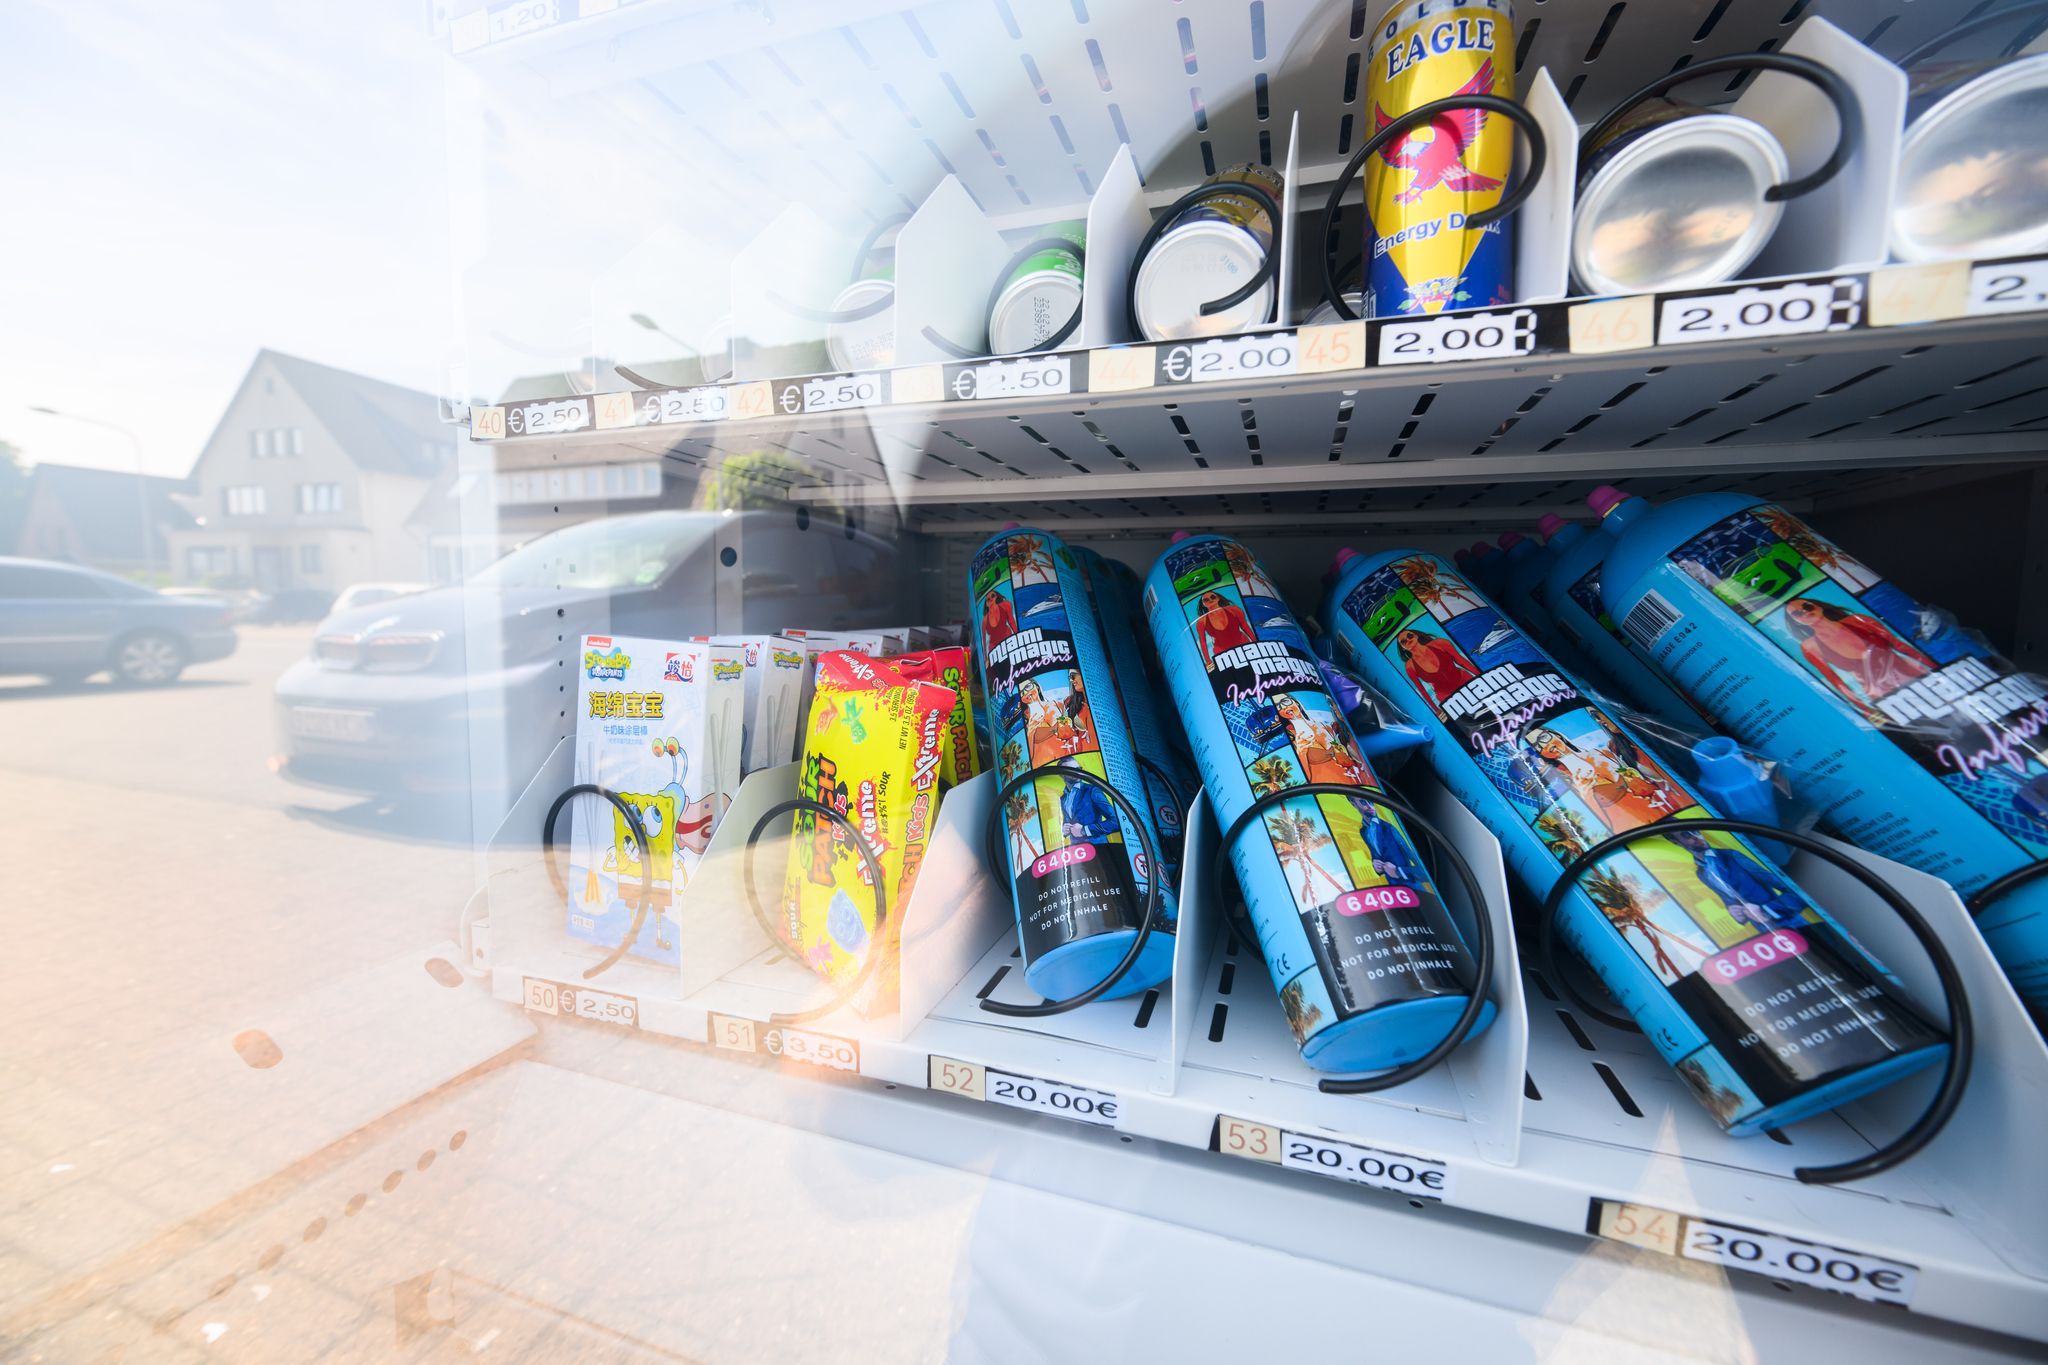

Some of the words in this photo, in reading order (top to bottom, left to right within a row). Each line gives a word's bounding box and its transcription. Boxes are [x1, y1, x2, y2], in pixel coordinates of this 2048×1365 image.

[1386, 18, 1495, 82] EAGLE
[1374, 219, 1441, 258] Energy
[1893, 273, 1954, 313] 47
[1581, 306, 1639, 341] 46
[1680, 296, 1815, 333] 2,00
[1304, 331, 1352, 365] 45
[1394, 326, 1506, 355] 2,00
[1098, 356, 1139, 385] 44
[1200, 346, 1292, 373] 2.00
[668, 396, 724, 416] 2.50
[736, 387, 767, 414] 42
[809, 383, 874, 407] 2.50
[478, 411, 502, 434] 40
[531, 407, 581, 427] 2.50
[605, 398, 628, 421] 41
[589, 691, 664, 719] 海绵宝宝
[899, 736, 908, 750] NET
[901, 724, 909, 737] WT
[878, 771, 891, 797] SOUR
[906, 793, 929, 843] Kids
[1037, 846, 1088, 874] 640G
[1038, 890, 1049, 902] DO
[1051, 884, 1068, 895] NOT
[1070, 876, 1100, 888] REFILL
[1346, 890, 1412, 912] 640G
[1029, 909, 1042, 923] NOT
[1043, 902, 1058, 915] FOR
[1060, 889, 1101, 906] MEDICAL
[1103, 888, 1121, 896] USE
[1041, 920, 1052, 931] DO
[1053, 913, 1070, 925] NOT
[1073, 903, 1109, 917] INHALE
[1354, 933, 1371, 945] DO
[1374, 929, 1397, 940] NOT
[1400, 925, 1435, 936] REFILL
[1340, 955, 1363, 969] NOT
[1366, 948, 1390, 961] FOR
[1393, 943, 1440, 955] MEDICAL
[1441, 944, 1457, 953] USE
[1367, 969, 1385, 981] DO
[1387, 963, 1411, 976] NOT
[1414, 959, 1453, 971] INHALE
[1715, 934, 1797, 979] 640G
[531, 985, 555, 1009] 50
[583, 998, 635, 1020] 2,50
[1744, 1002, 1766, 1018] DO
[1769, 989, 1798, 1008] NOT
[1800, 972, 1844, 995] REFILL
[1737, 1029, 1767, 1048] NOT
[1769, 1016, 1798, 1036] FOR
[1799, 994, 1857, 1022] MEDICAL
[1857, 985, 1883, 1000] USE
[727, 1023, 750, 1047] 51
[1776, 1043, 1800, 1059] DO
[1801, 1028, 1832, 1048] NOT
[1834, 1010, 1887, 1035] INHALE
[789, 1034, 854, 1064] 3,50
[942, 1063, 975, 1093] 52
[995, 1081, 1118, 1119] 20.00€
[1228, 1122, 1269, 1155] 53
[1289, 1142, 1446, 1190] 20.00€
[1613, 1204, 1666, 1244] 54
[1692, 1231, 1904, 1292] 20.00€
